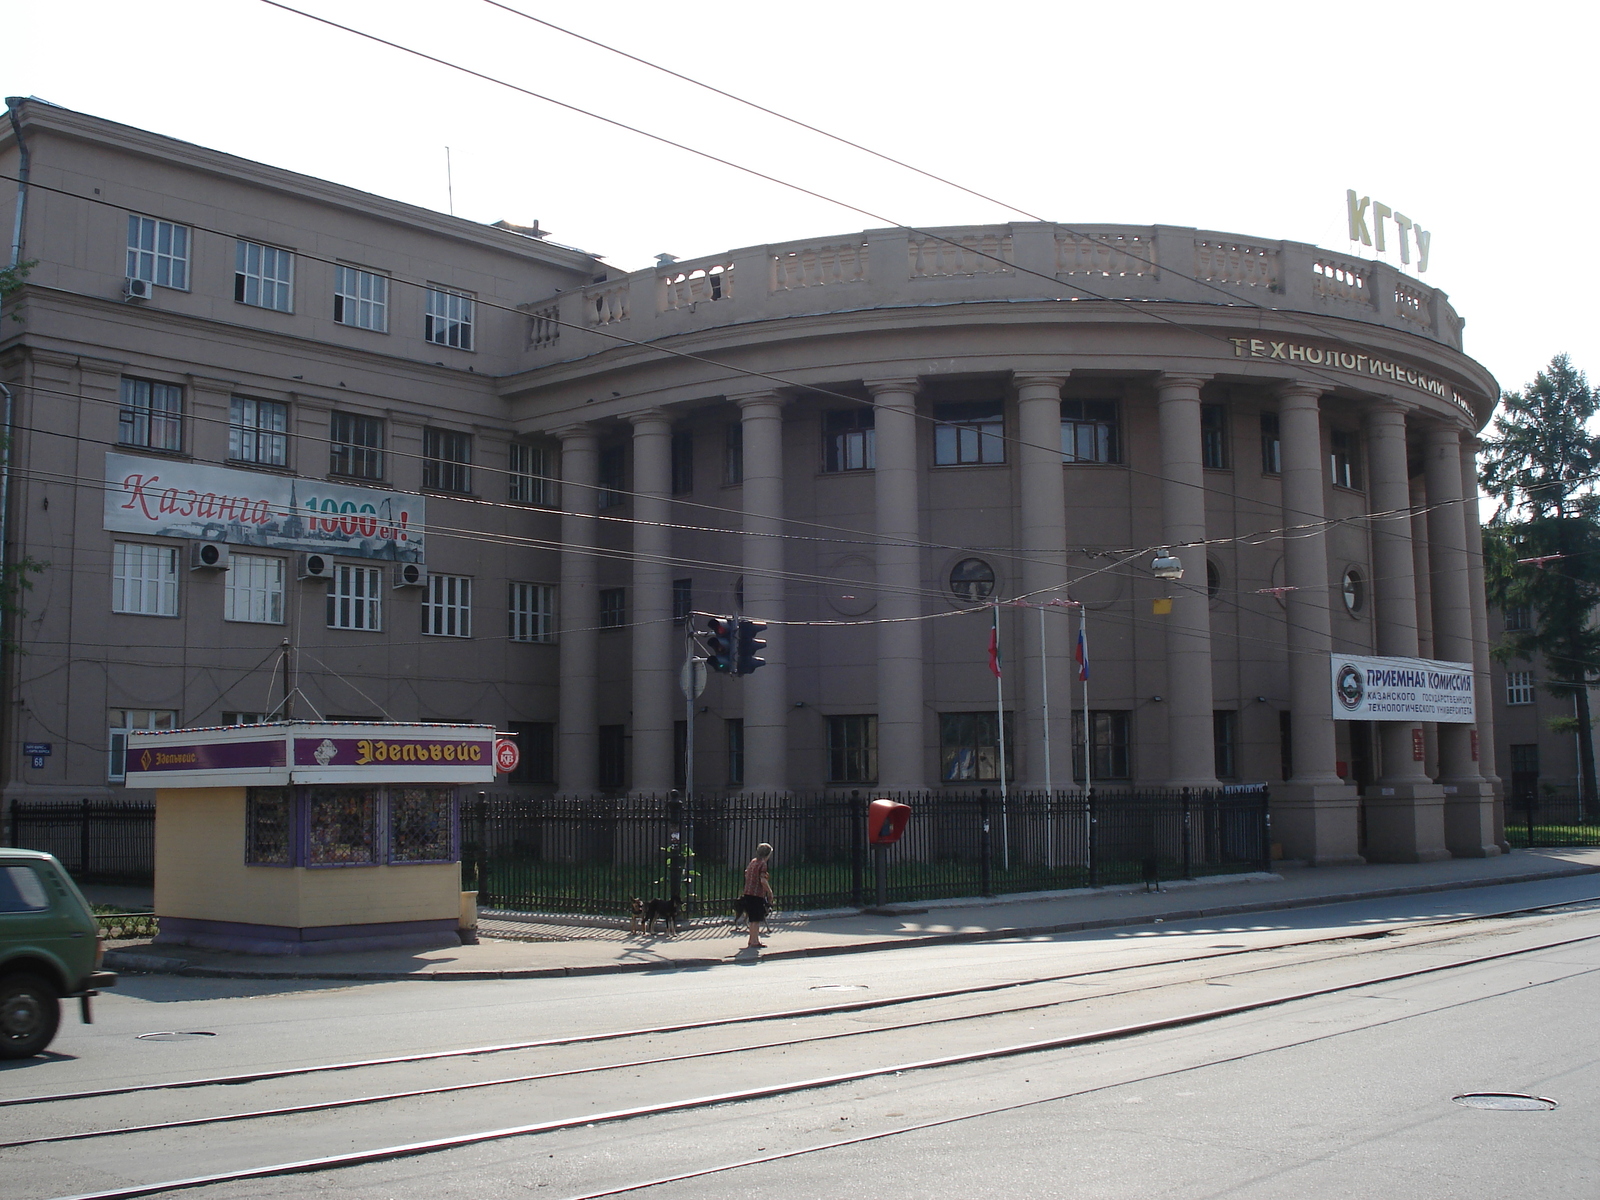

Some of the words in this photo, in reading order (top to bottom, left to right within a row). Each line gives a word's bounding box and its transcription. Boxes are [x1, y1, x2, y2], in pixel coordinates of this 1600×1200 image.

[1347, 189, 1431, 273] КГТУ
[121, 473, 272, 524] Казанга
[305, 497, 377, 537] 1000
[1366, 669, 1426, 689] ПРИЕМНАЯ
[1428, 672, 1472, 692] КОМИССИЯ
[1367, 691, 1416, 701] КАЗАНСКОГО
[1422, 693, 1472, 705] ГОСУДАРСТВЕННОГО
[1368, 703, 1435, 714] ТЕХНОЛОГИЧЕСКОГО
[1437, 705, 1473, 716] УНИВЕРСИТЕТА
[34, 757, 43, 767] 68
[355, 739, 481, 765] Эдельвейс
